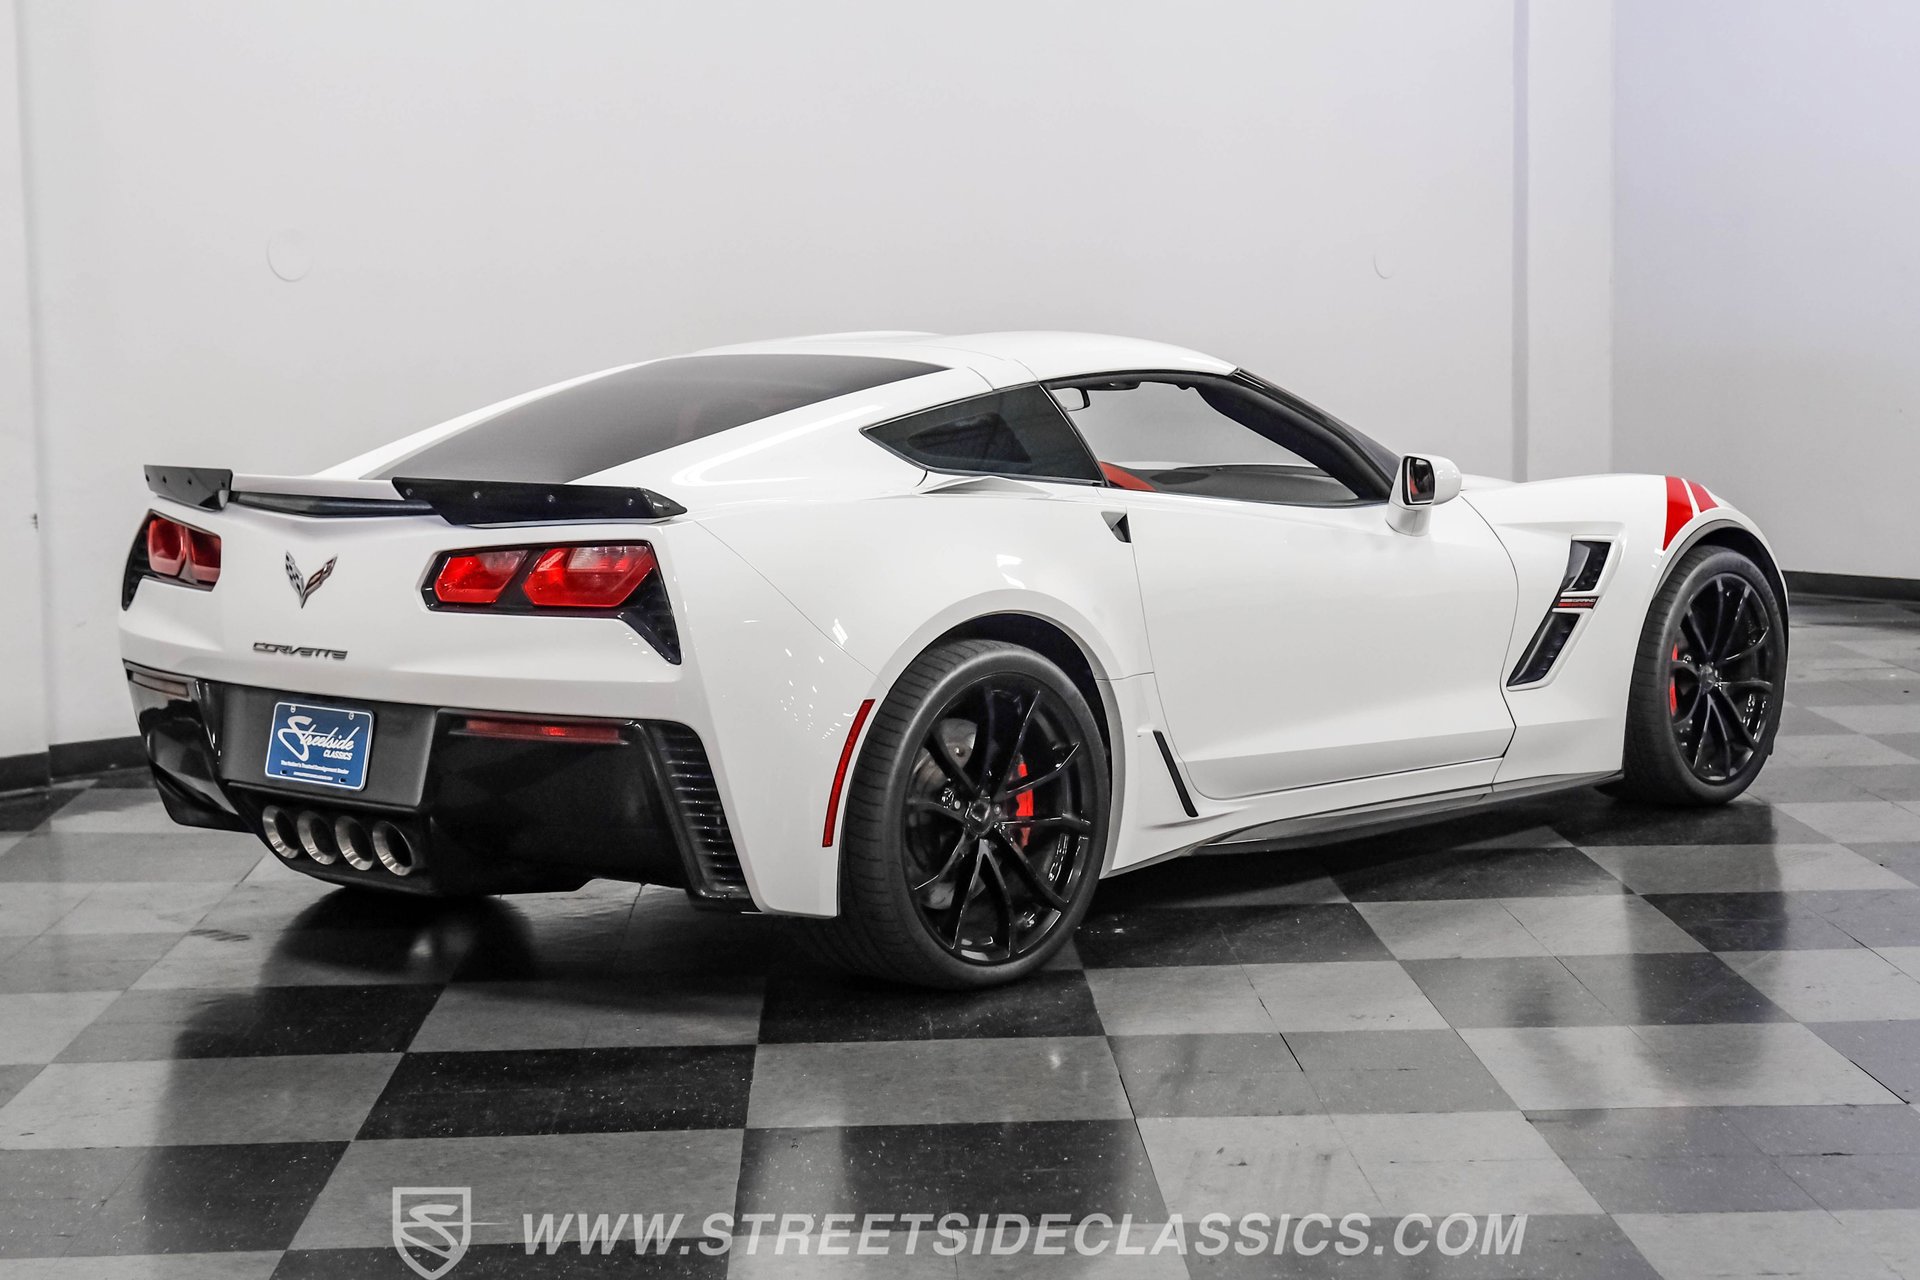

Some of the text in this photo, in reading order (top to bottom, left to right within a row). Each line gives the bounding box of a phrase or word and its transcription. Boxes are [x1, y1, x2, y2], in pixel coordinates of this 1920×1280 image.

[253, 642, 348, 660] CORVETTE
[277, 715, 360, 761] Streetside
[323, 749, 353, 761] CLASSICS
